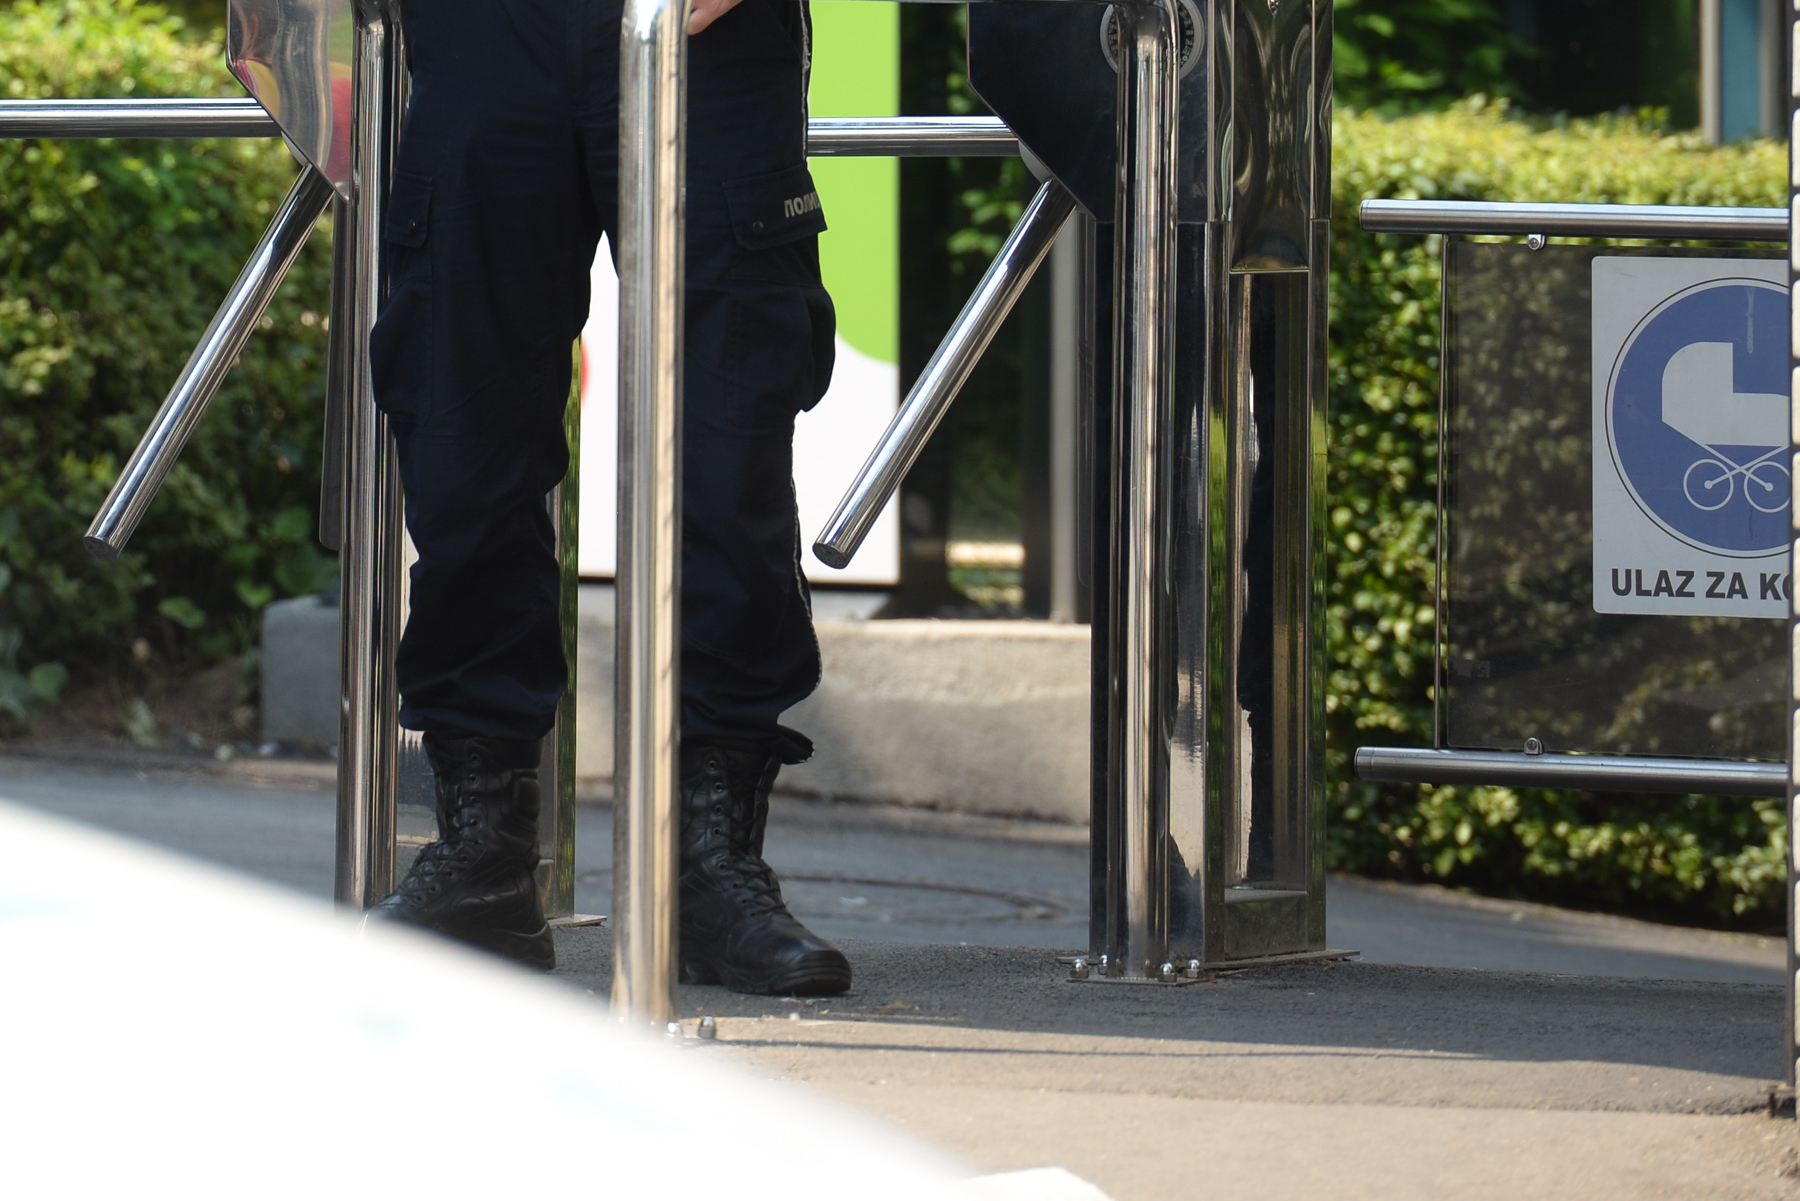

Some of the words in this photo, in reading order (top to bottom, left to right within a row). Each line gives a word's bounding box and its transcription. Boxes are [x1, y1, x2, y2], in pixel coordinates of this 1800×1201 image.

[784, 191, 820, 218] ПОЛИ
[1611, 568, 1695, 598] ULAZ
[1705, 571, 1749, 601] ZA
[1759, 572, 1790, 601] K
